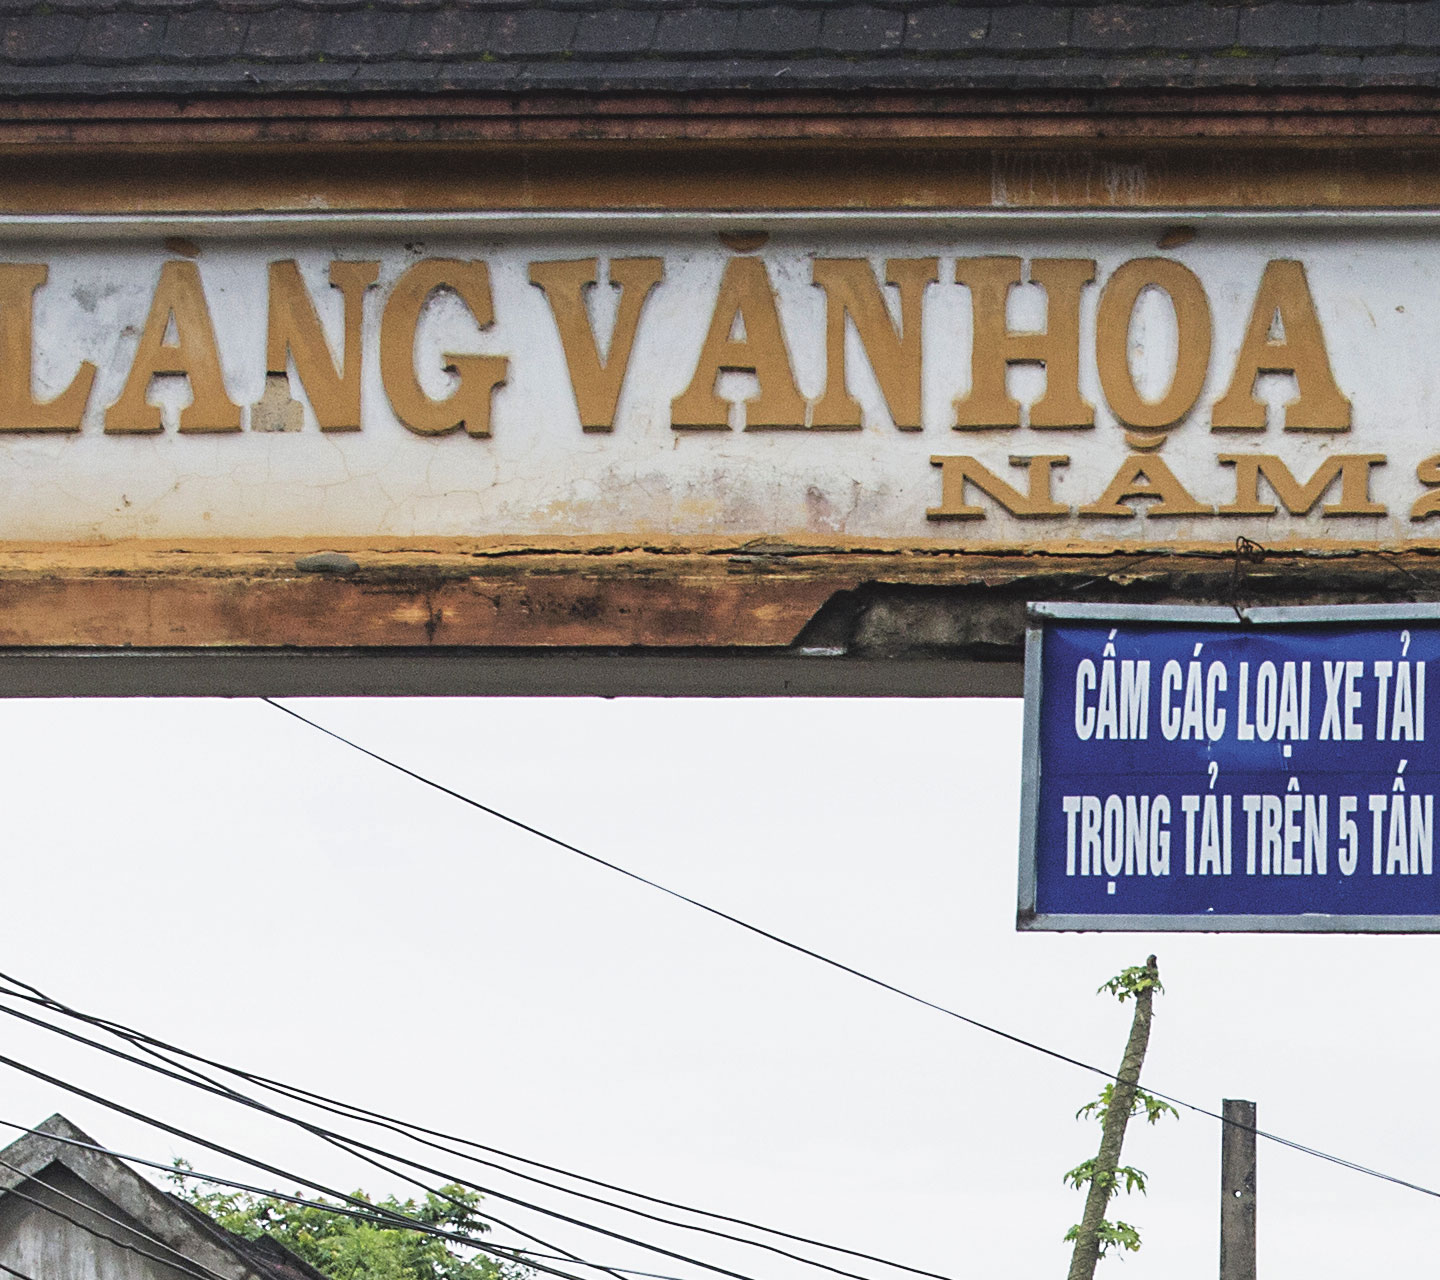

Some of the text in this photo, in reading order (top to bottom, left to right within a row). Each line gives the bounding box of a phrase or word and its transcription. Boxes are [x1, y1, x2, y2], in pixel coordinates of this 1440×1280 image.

[1074, 629, 1427, 758] CẤM CÁC LOẠI XE TẢI
[1062, 759, 1434, 895] TRỌNG TẢI TRÊN 5 TẤN
